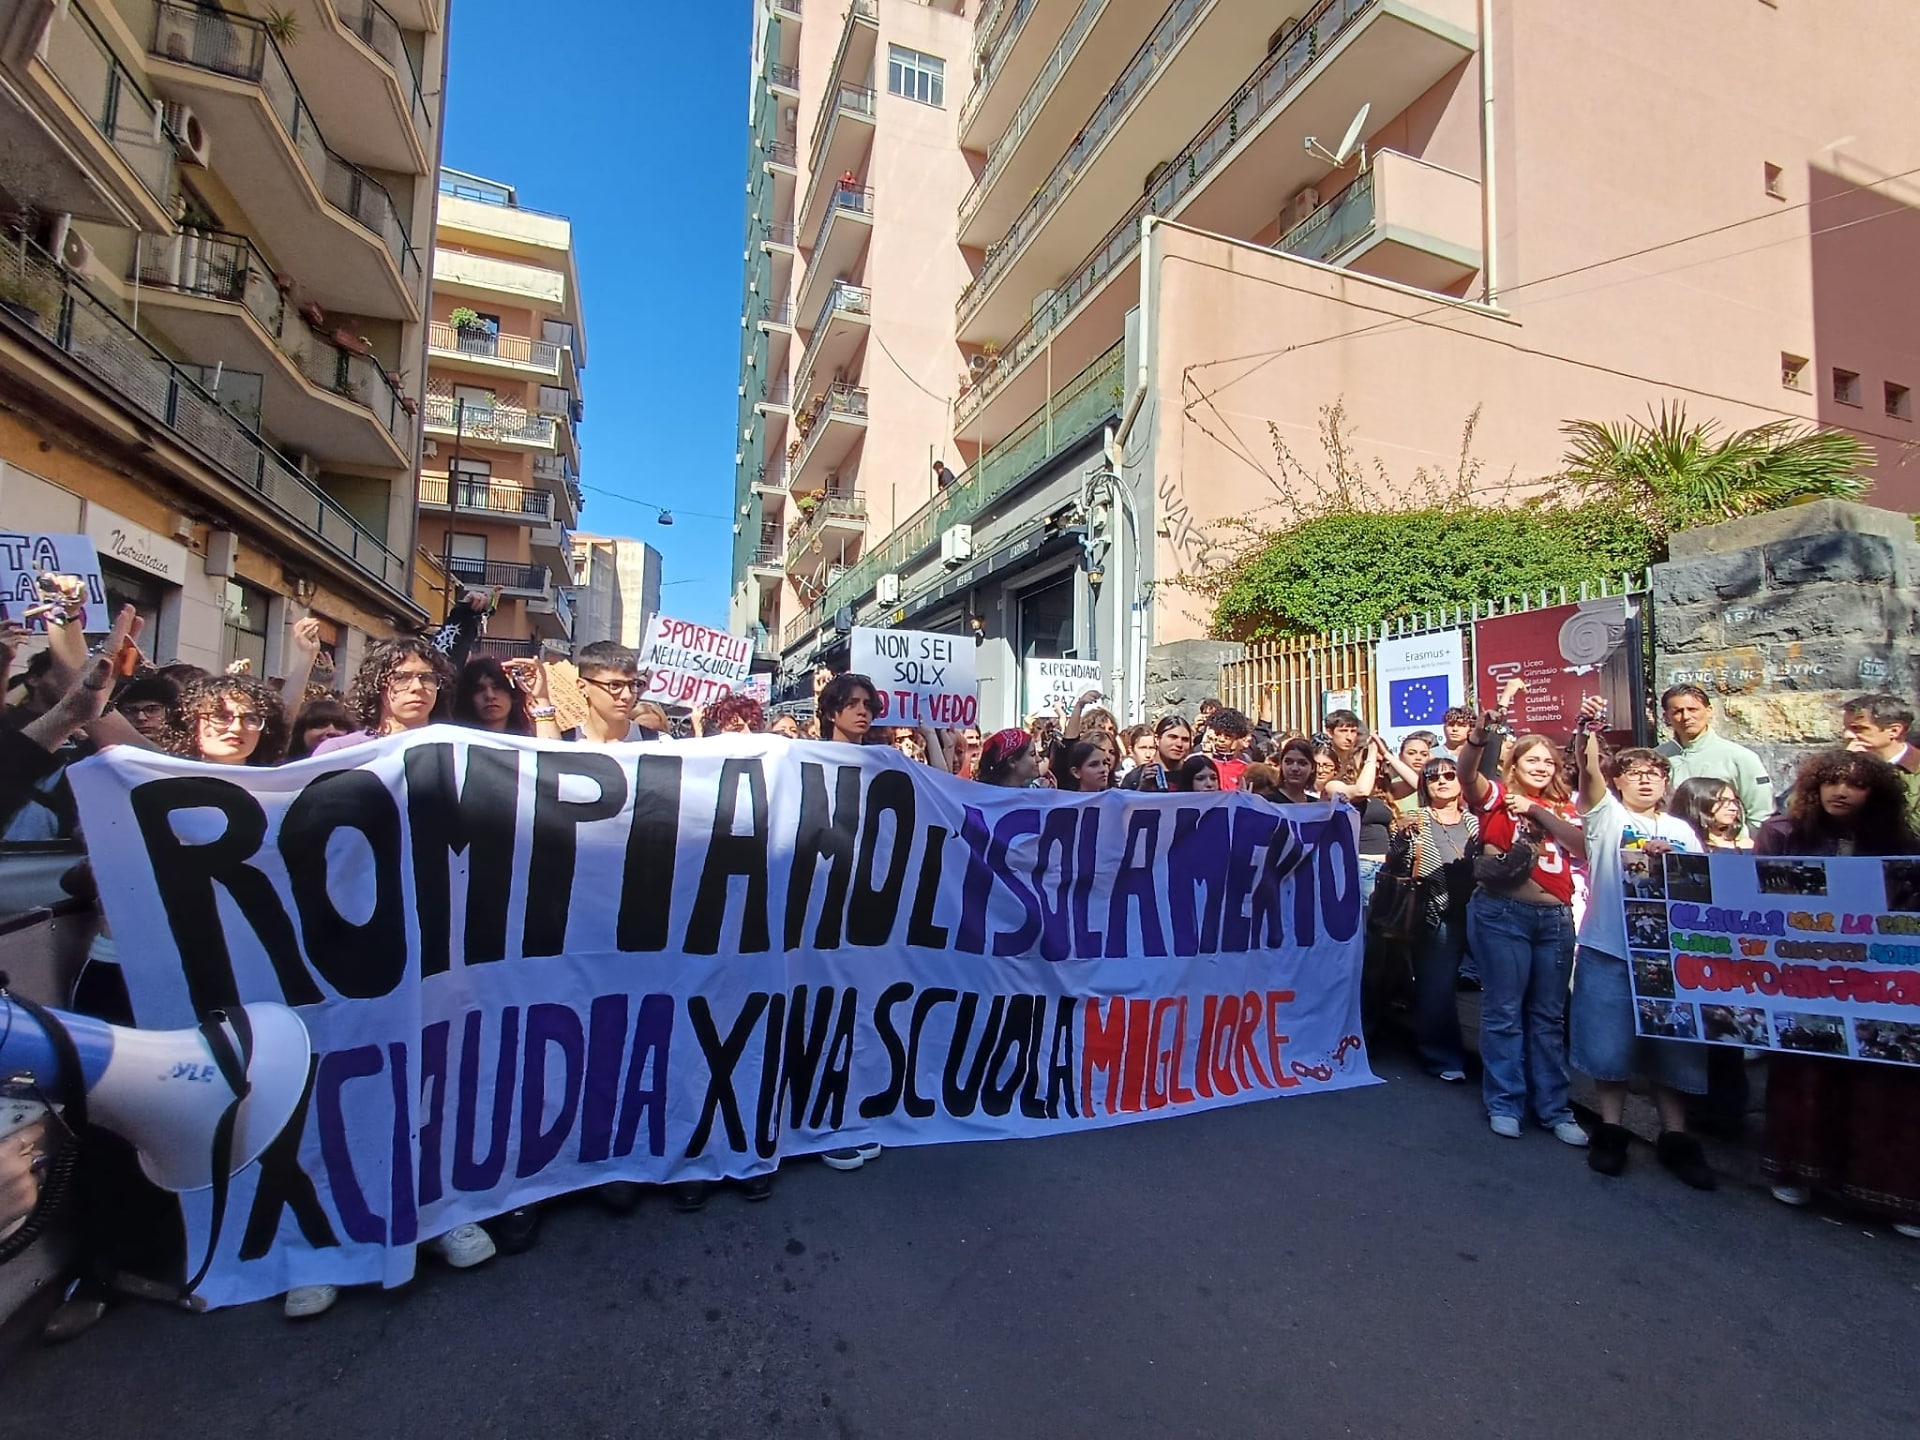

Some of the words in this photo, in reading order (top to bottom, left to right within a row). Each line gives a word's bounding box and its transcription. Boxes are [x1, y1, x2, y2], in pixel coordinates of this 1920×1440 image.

[658, 619, 748, 663] SPORTELLI
[875, 634, 909, 659] NON
[920, 638, 952, 663] SEI
[1040, 662, 1101, 680] RIPRENDIAMO
[1523, 660, 1544, 668] Liceo
[894, 661, 945, 687] SOLX
[1524, 668, 1558, 677] Ginnasio
[1053, 680, 1074, 692] GLI
[1042, 694, 1077, 708] SPAZ
[1525, 695, 1551, 703] Cutelli
[929, 693, 977, 726] VEDO
[1525, 705, 1560, 713] Carmelo
[1526, 713, 1562, 722] Salanitro
[130, 742, 916, 1020] ROMPIAMO
[859, 981, 1079, 1120] SCUOLA
[1080, 989, 1302, 1118] MIGLIORE
